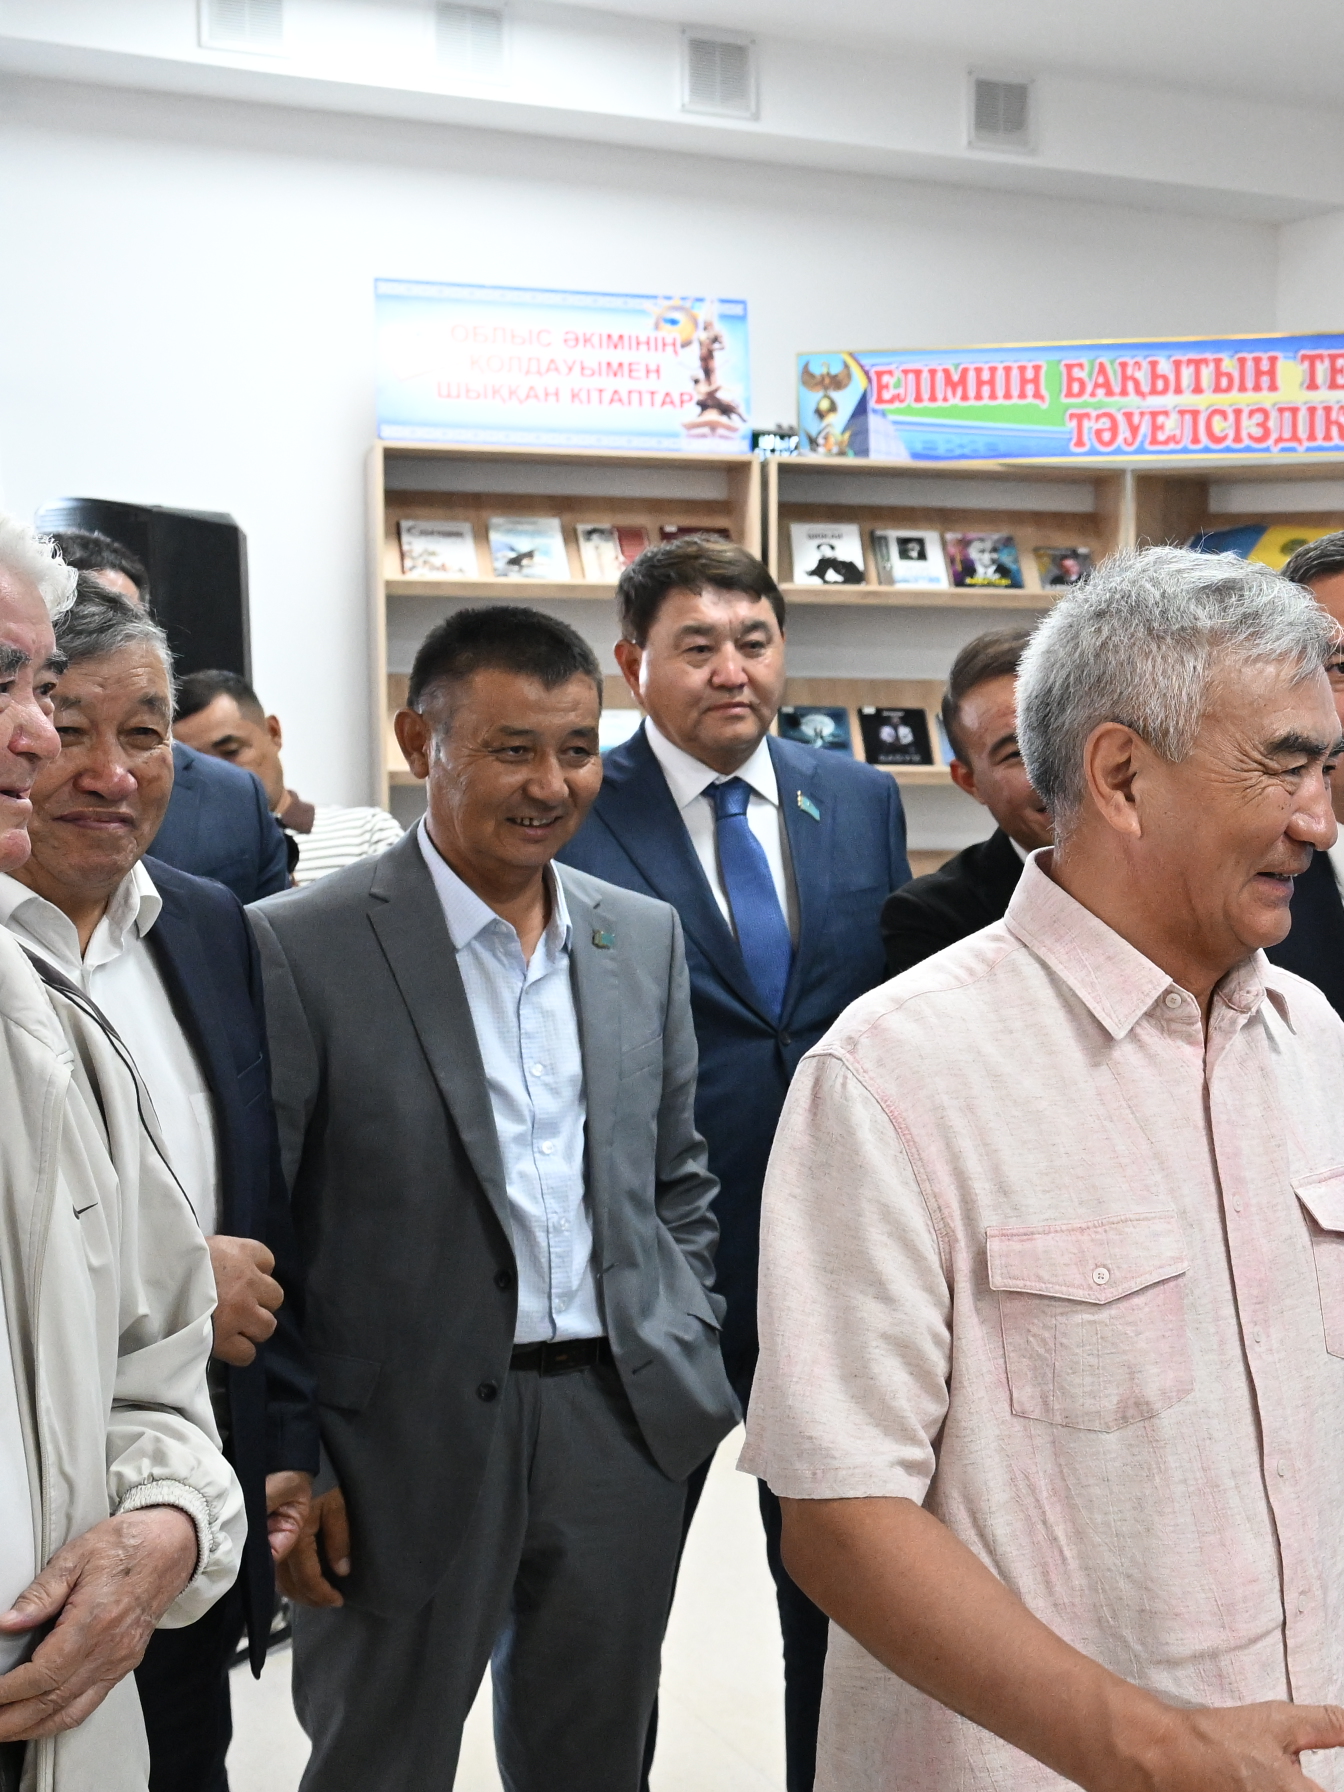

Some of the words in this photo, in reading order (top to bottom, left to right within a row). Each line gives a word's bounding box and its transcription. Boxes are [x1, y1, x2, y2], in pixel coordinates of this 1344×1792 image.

[450, 324, 552, 348] ОБЛЫС
[562, 330, 680, 358] ӘКІМІНІҢ
[469, 354, 662, 381] ҚОЛДАУЫМЕН
[872, 361, 1046, 406] ЕЛІМНІҢ
[1060, 351, 1280, 406] БАҚЫТЫН
[436, 381, 560, 406] ШЫҚҚАН
[570, 386, 695, 410] КІТАПТАР
